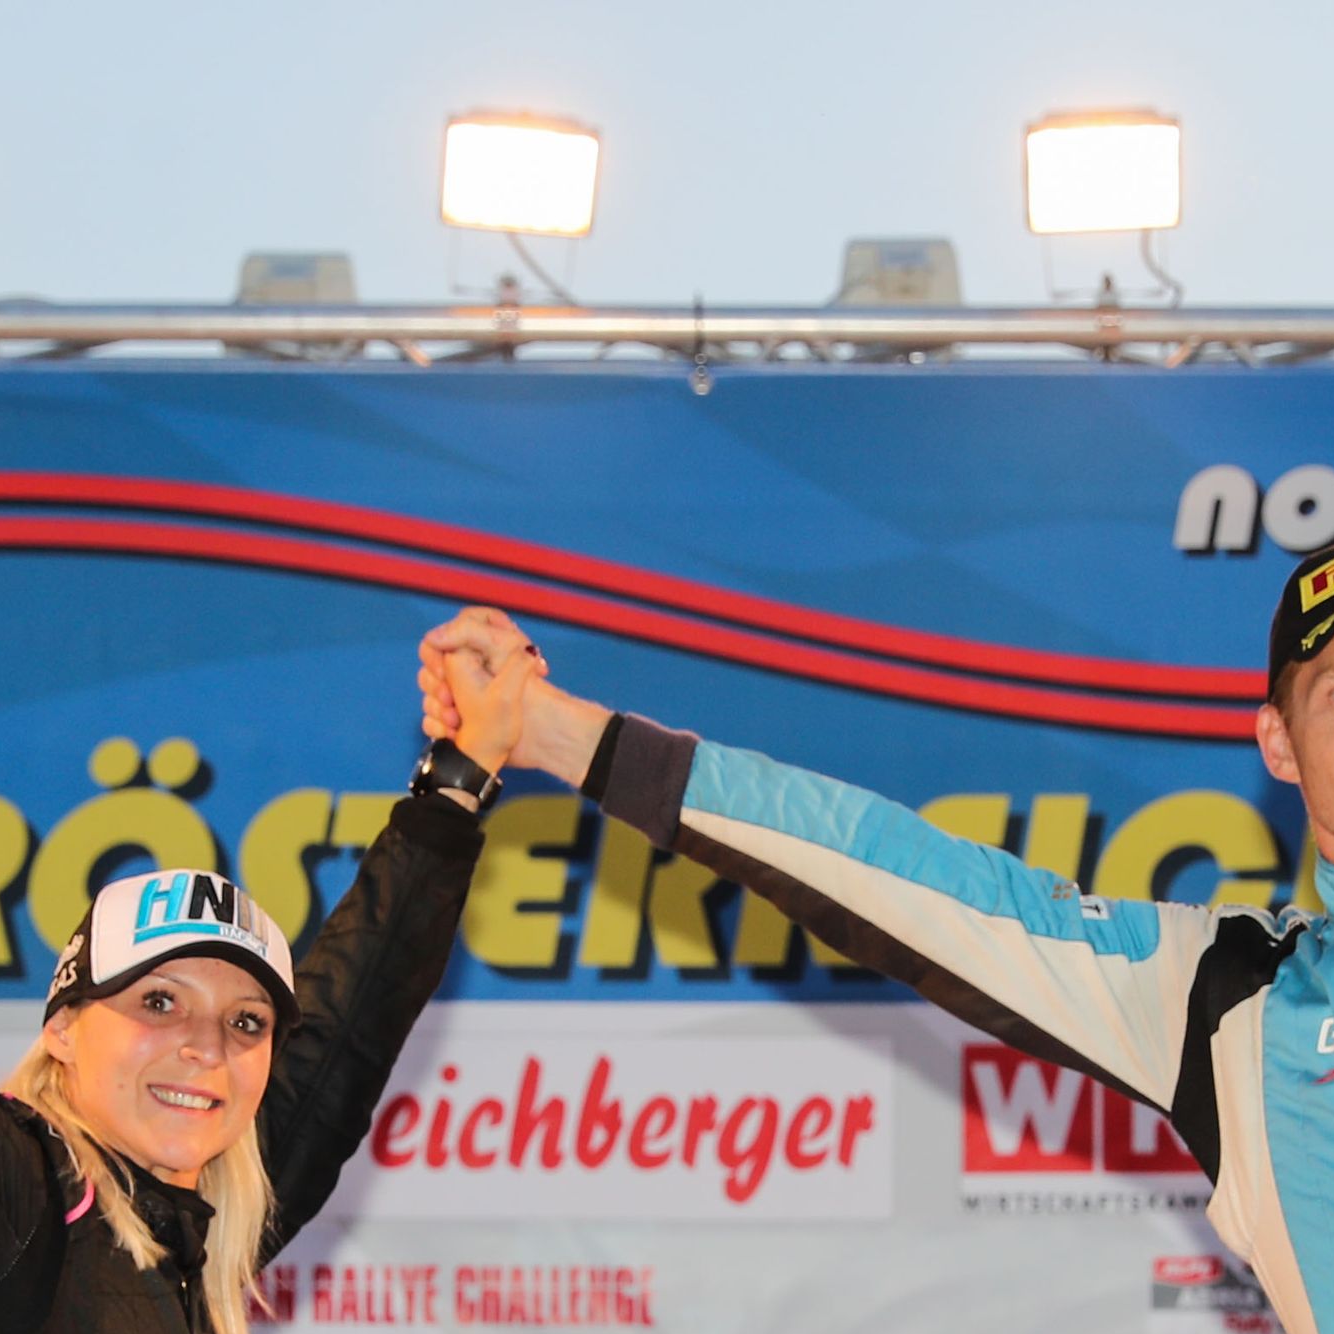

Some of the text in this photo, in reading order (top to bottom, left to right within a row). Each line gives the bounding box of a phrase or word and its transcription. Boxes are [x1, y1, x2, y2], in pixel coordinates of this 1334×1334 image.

[371, 1055, 875, 1203] eichberger
[312, 1265, 440, 1326] RALLYE
[453, 1265, 656, 1327] CHALLENGE
